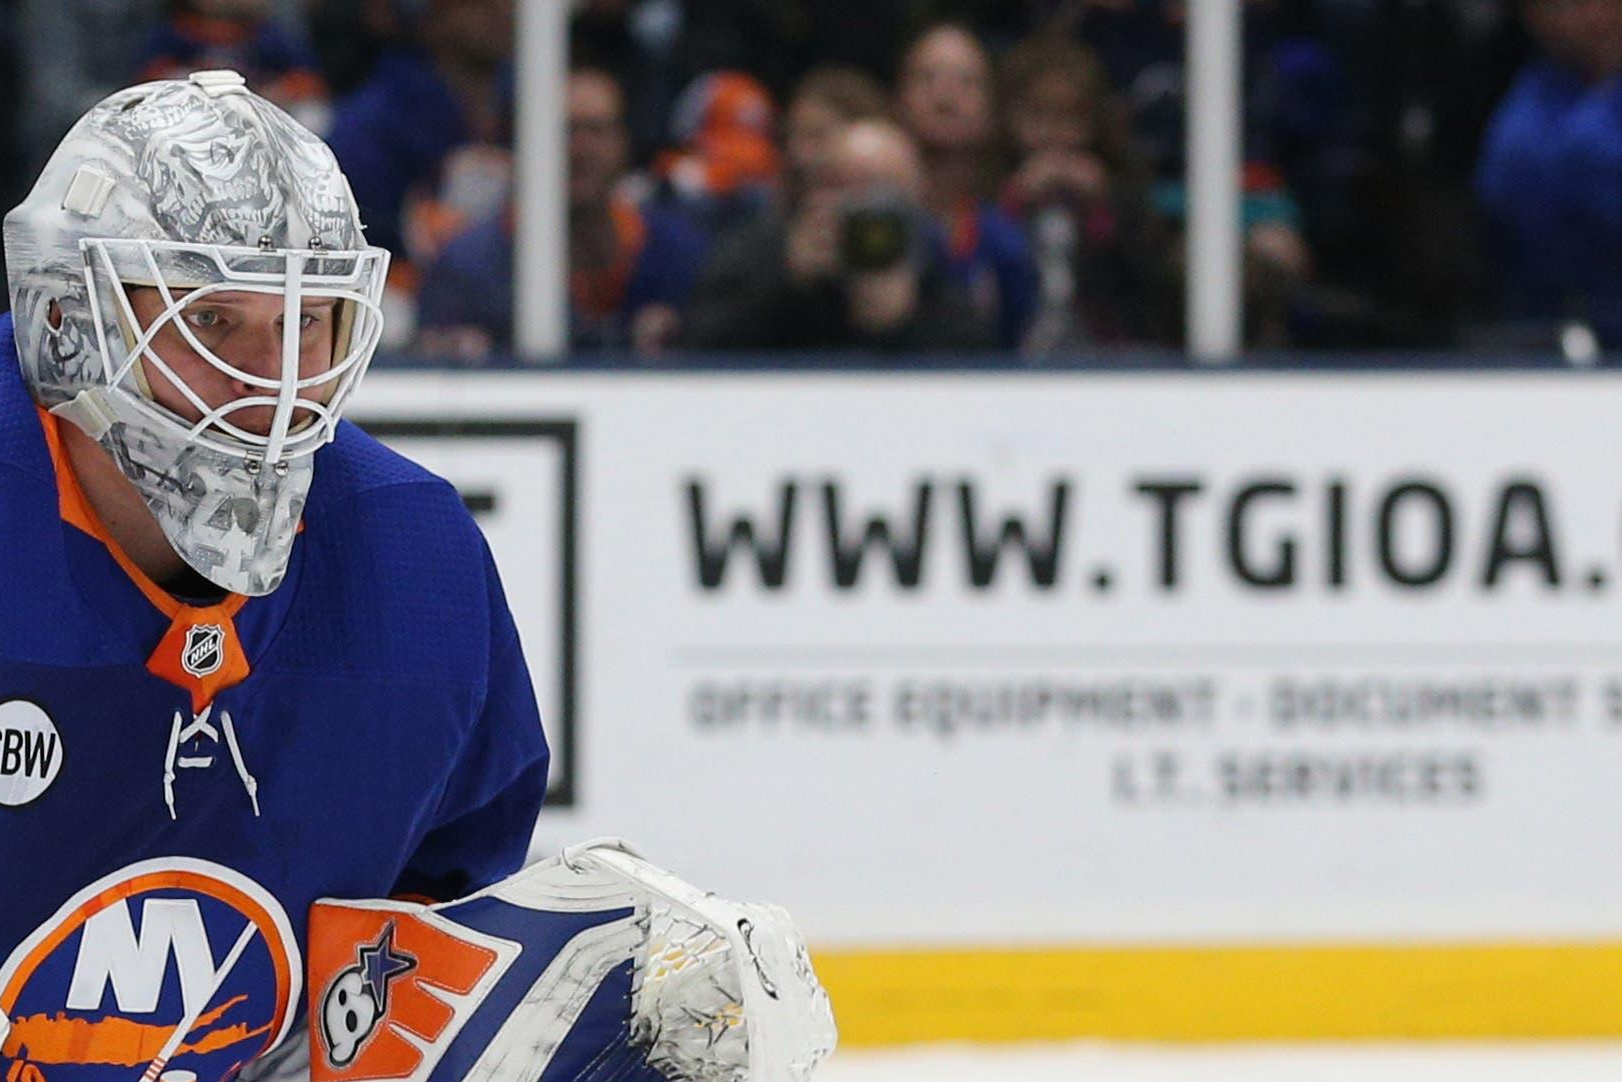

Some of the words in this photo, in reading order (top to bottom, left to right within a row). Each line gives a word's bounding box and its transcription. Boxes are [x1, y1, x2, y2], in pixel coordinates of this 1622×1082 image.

[190, 638, 216, 665] NHL
[691, 681, 872, 730] OFFICE
[894, 680, 1216, 742] EQUIPMENT
[1269, 676, 1579, 730] DOCUMENT
[1215, 747, 1483, 801] SERVICES
[65, 898, 256, 1020] NY
